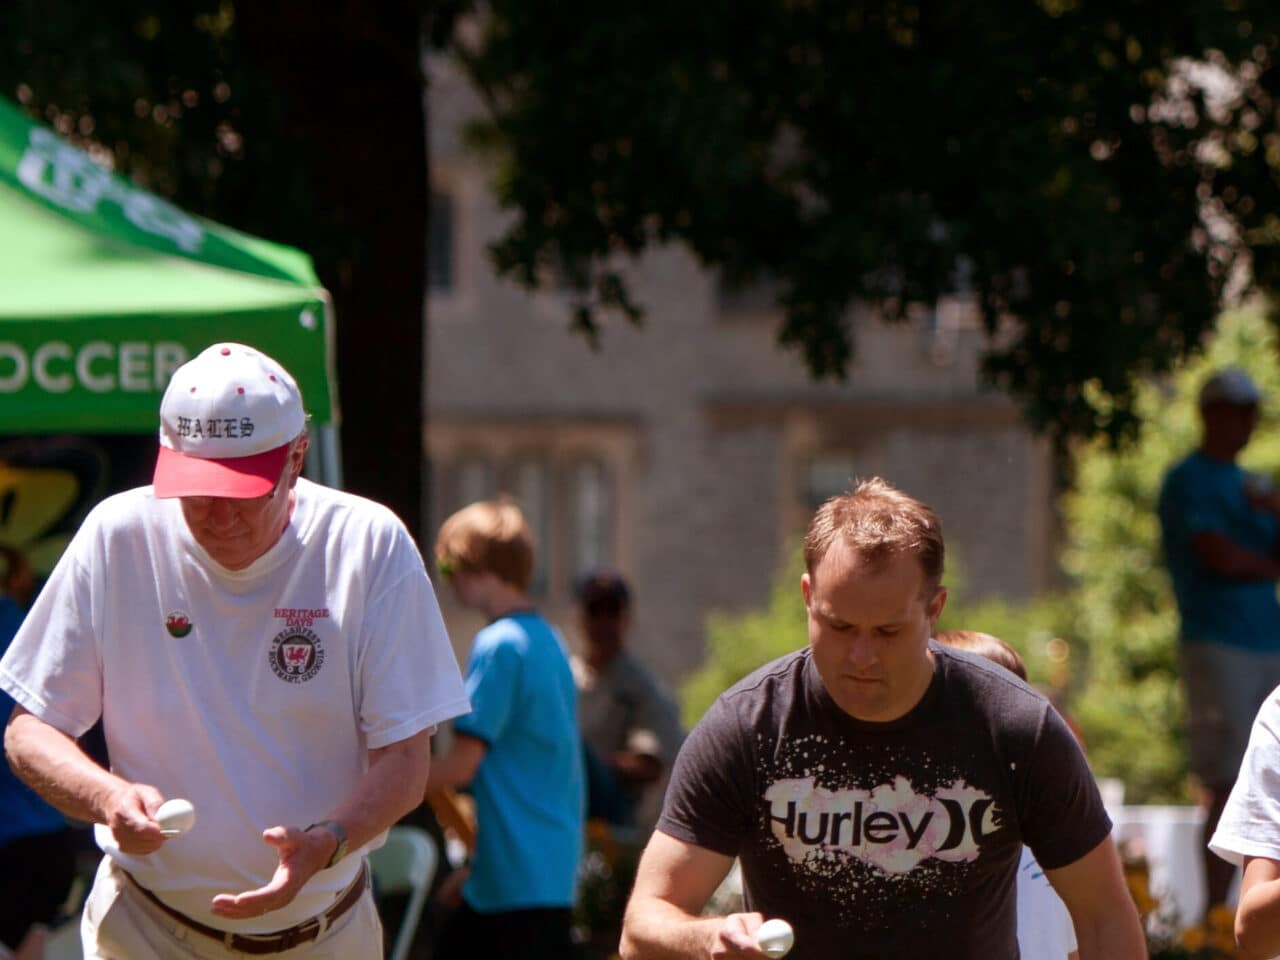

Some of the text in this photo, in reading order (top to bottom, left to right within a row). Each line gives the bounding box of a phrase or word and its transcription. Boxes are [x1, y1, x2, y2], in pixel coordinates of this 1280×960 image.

[177, 415, 255, 439] WALES
[274, 608, 329, 618] HERITAGE
[286, 618, 313, 627] DAYS
[768, 800, 934, 850] Hurley
